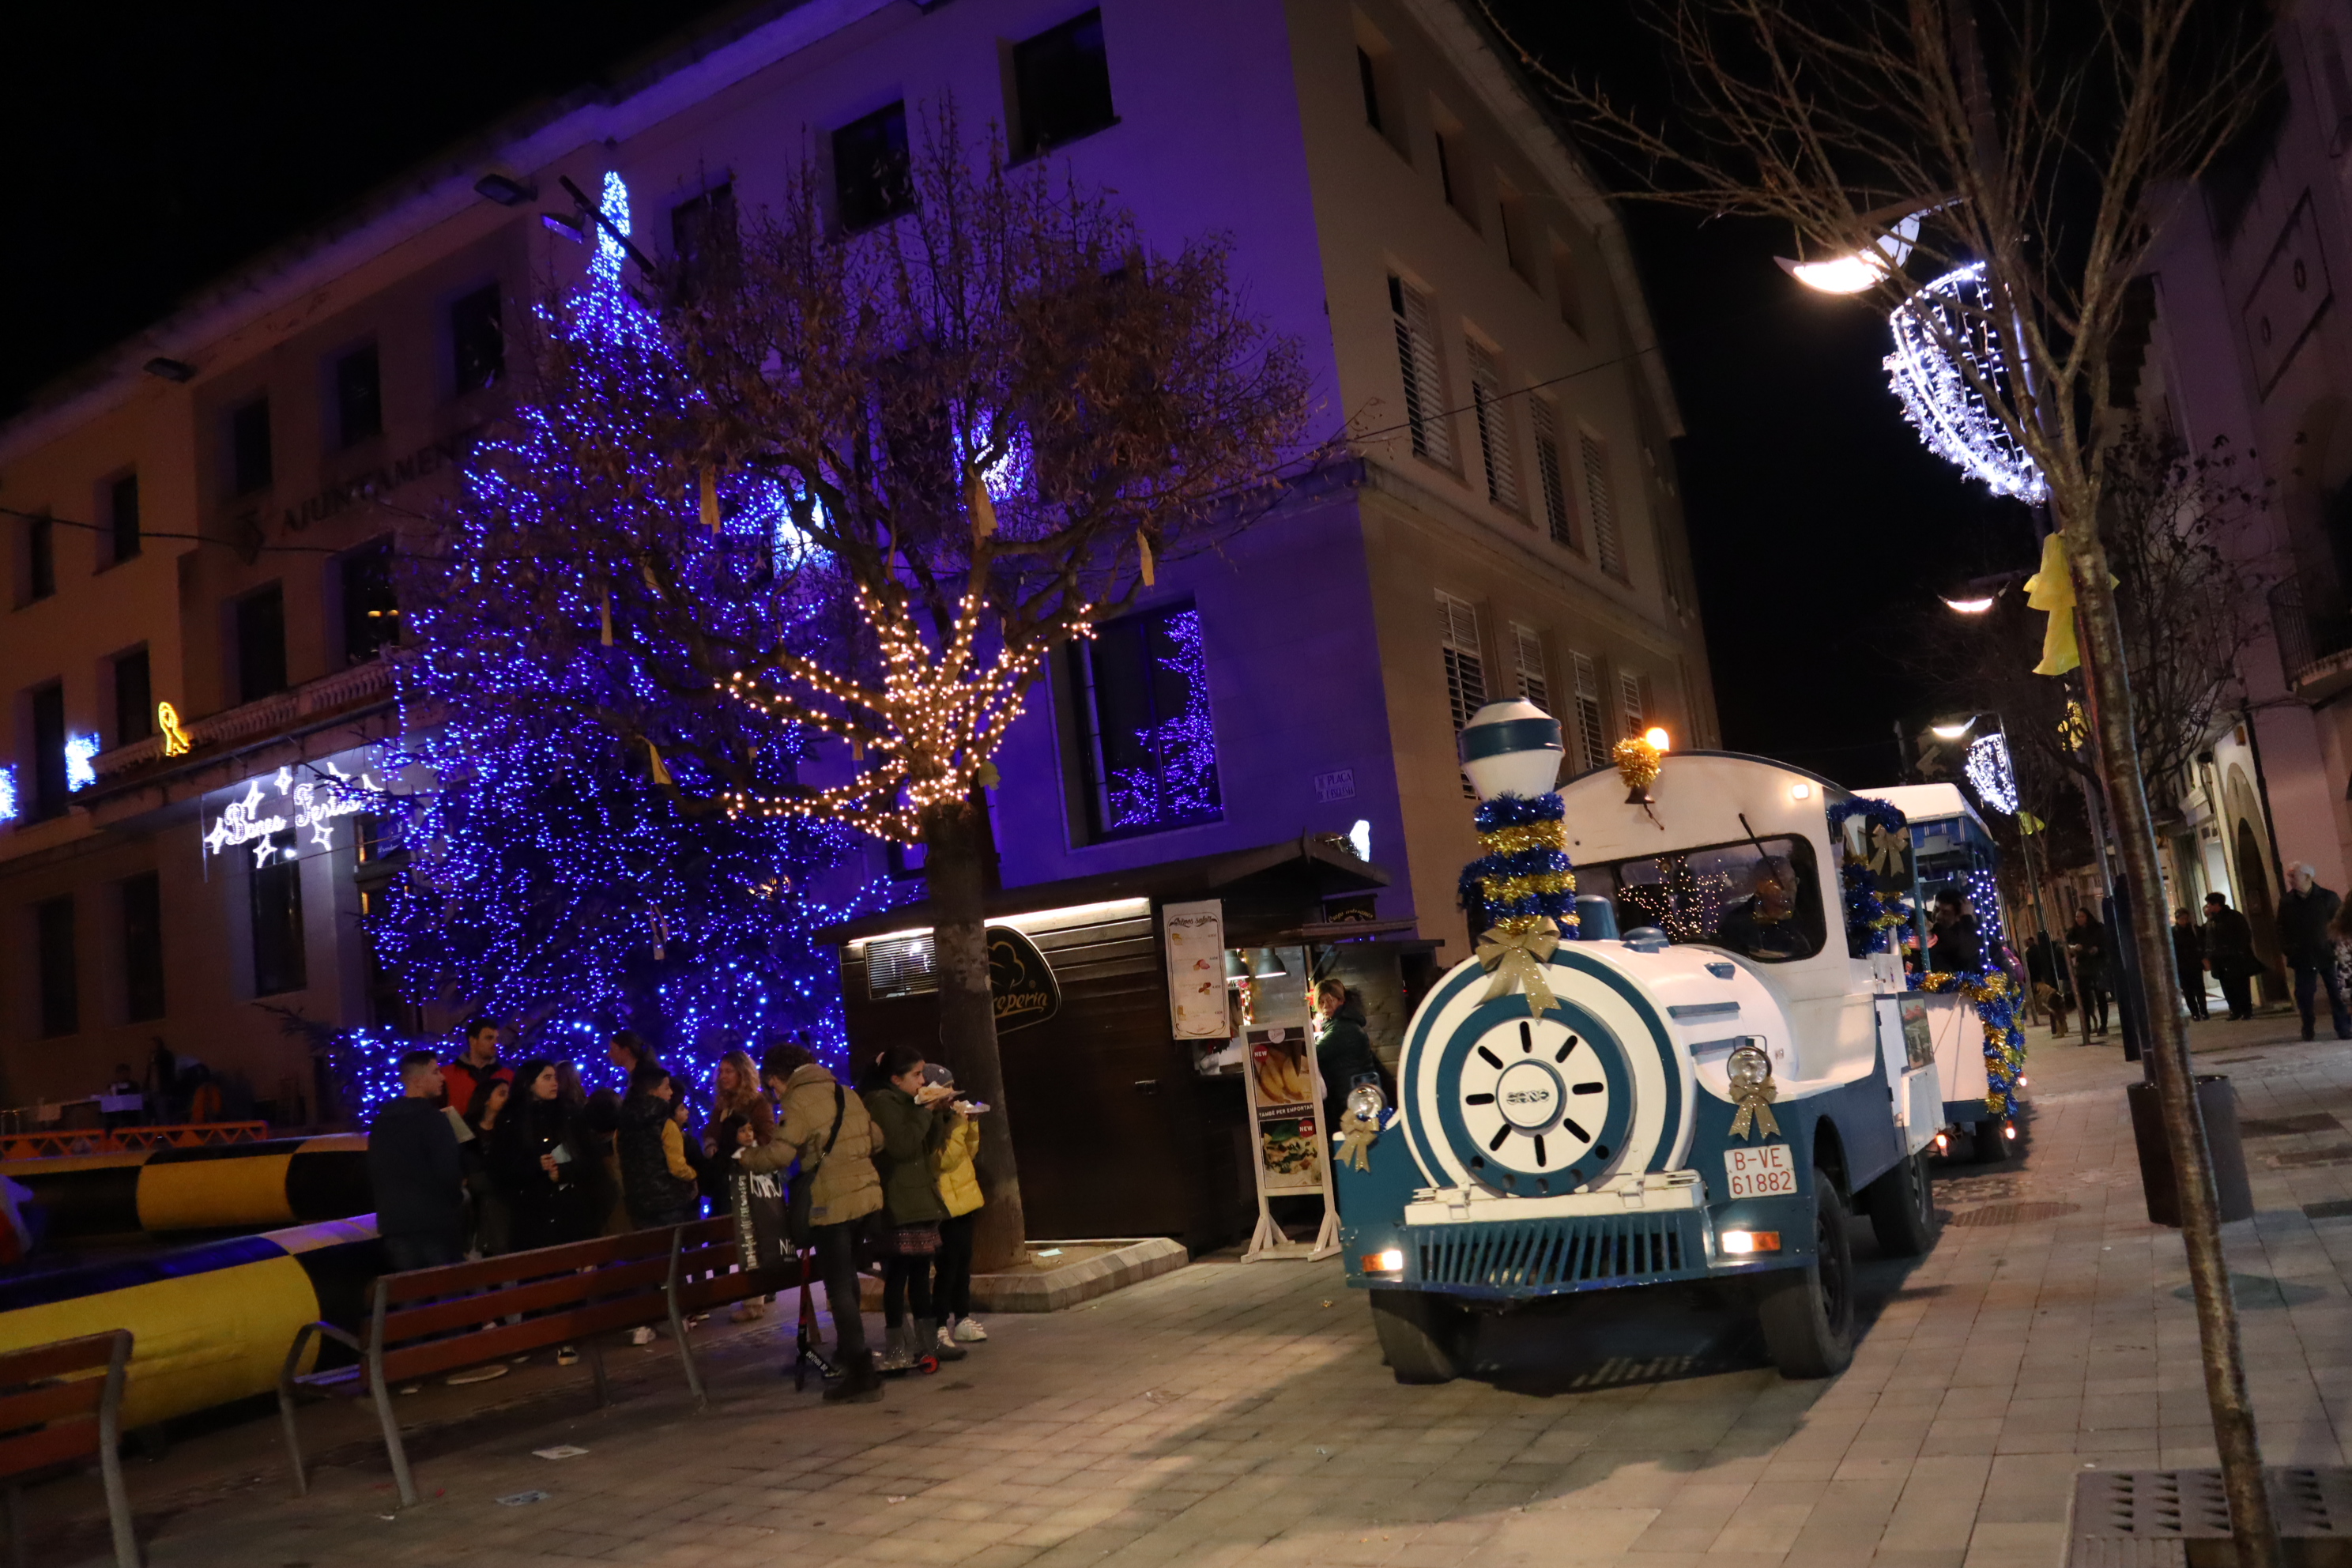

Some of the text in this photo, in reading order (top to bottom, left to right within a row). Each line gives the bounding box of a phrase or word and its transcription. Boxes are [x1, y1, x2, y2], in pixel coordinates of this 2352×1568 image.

[224, 802, 287, 846] Bones
[993, 991, 1048, 1015] reperia
[1287, 1105, 1314, 1114] EMPORTAR
[1734, 1148, 1783, 1170] B-VE
[1732, 1170, 1792, 1194] 61882
